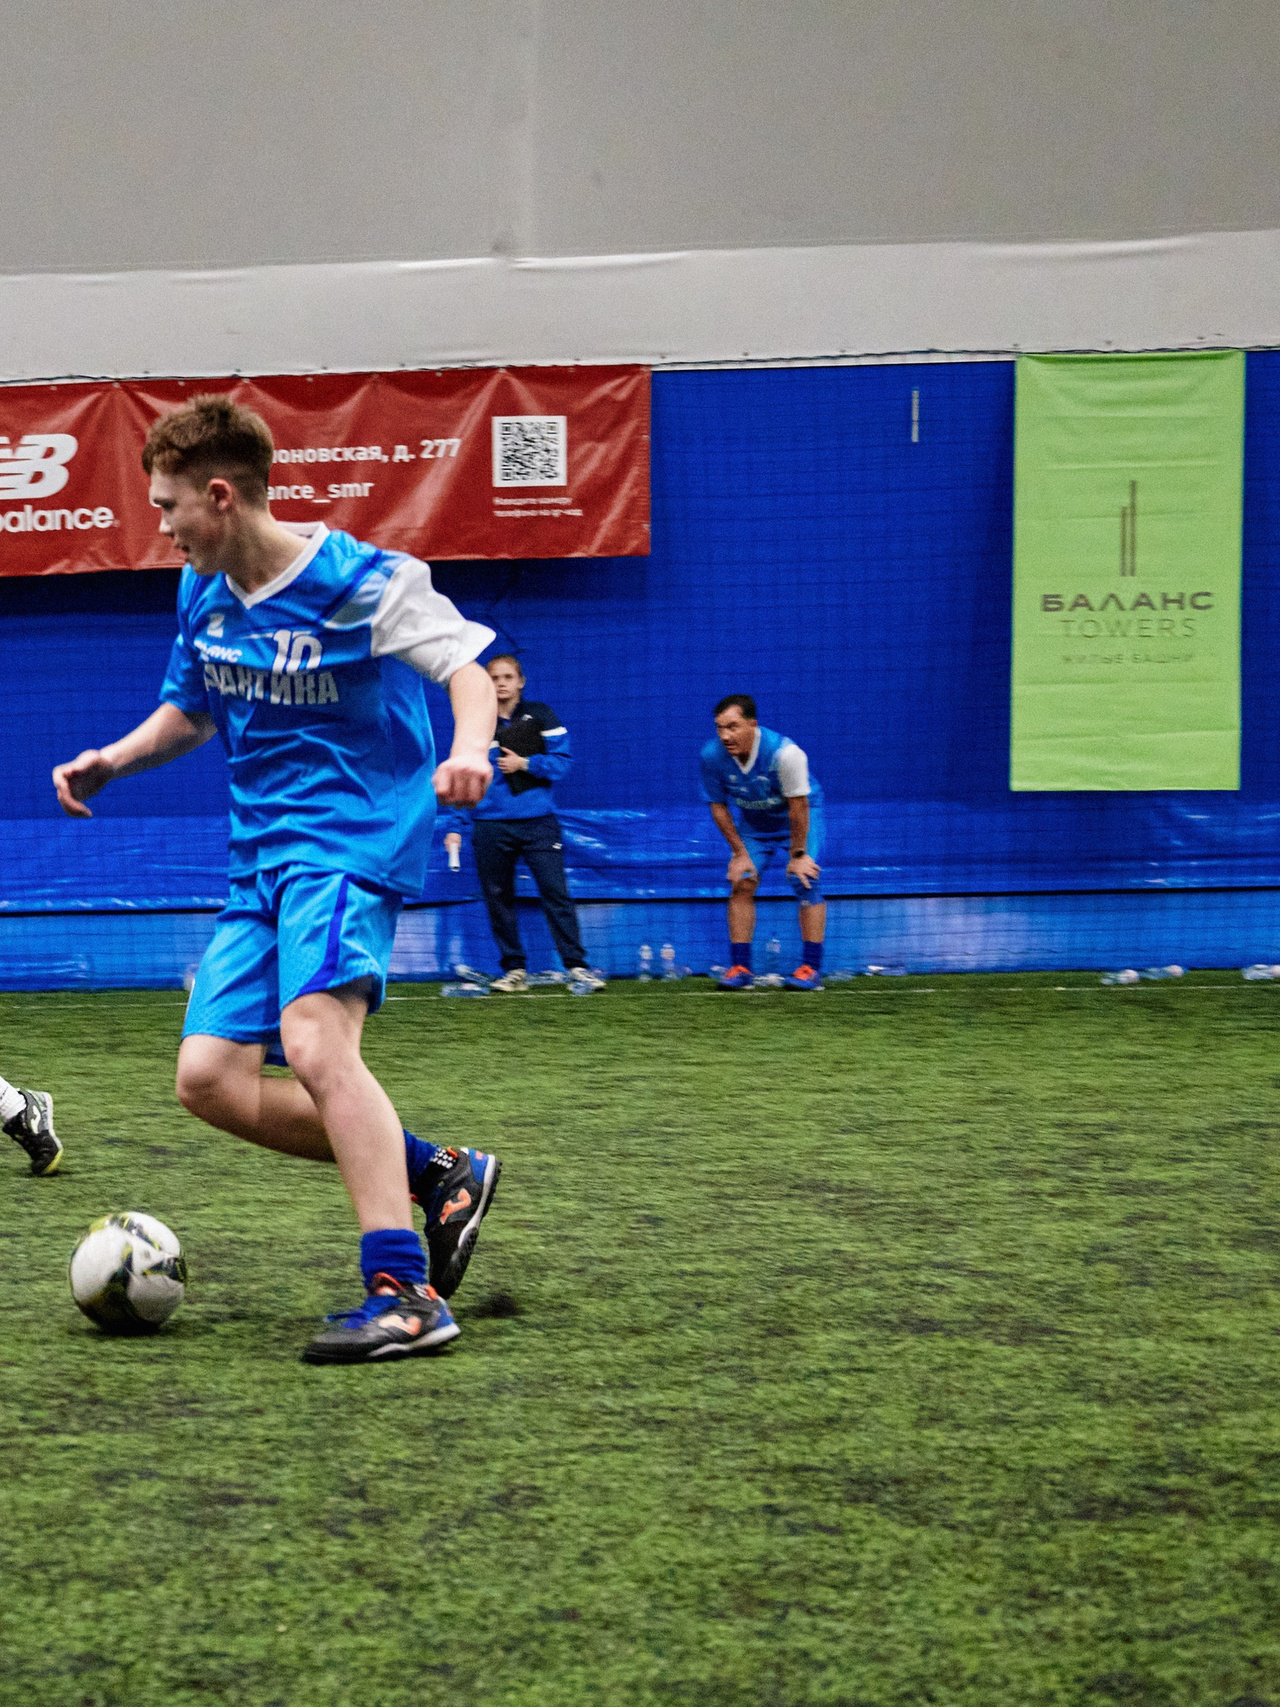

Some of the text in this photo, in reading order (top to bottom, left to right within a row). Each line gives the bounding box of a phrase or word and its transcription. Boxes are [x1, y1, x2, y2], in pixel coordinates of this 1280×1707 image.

[393, 443, 417, 464] д.
[420, 438, 462, 460] 277
[1040, 591, 1216, 612] БАЛАНС
[1060, 618, 1197, 639] TOWERS
[272, 629, 323, 676] 10
